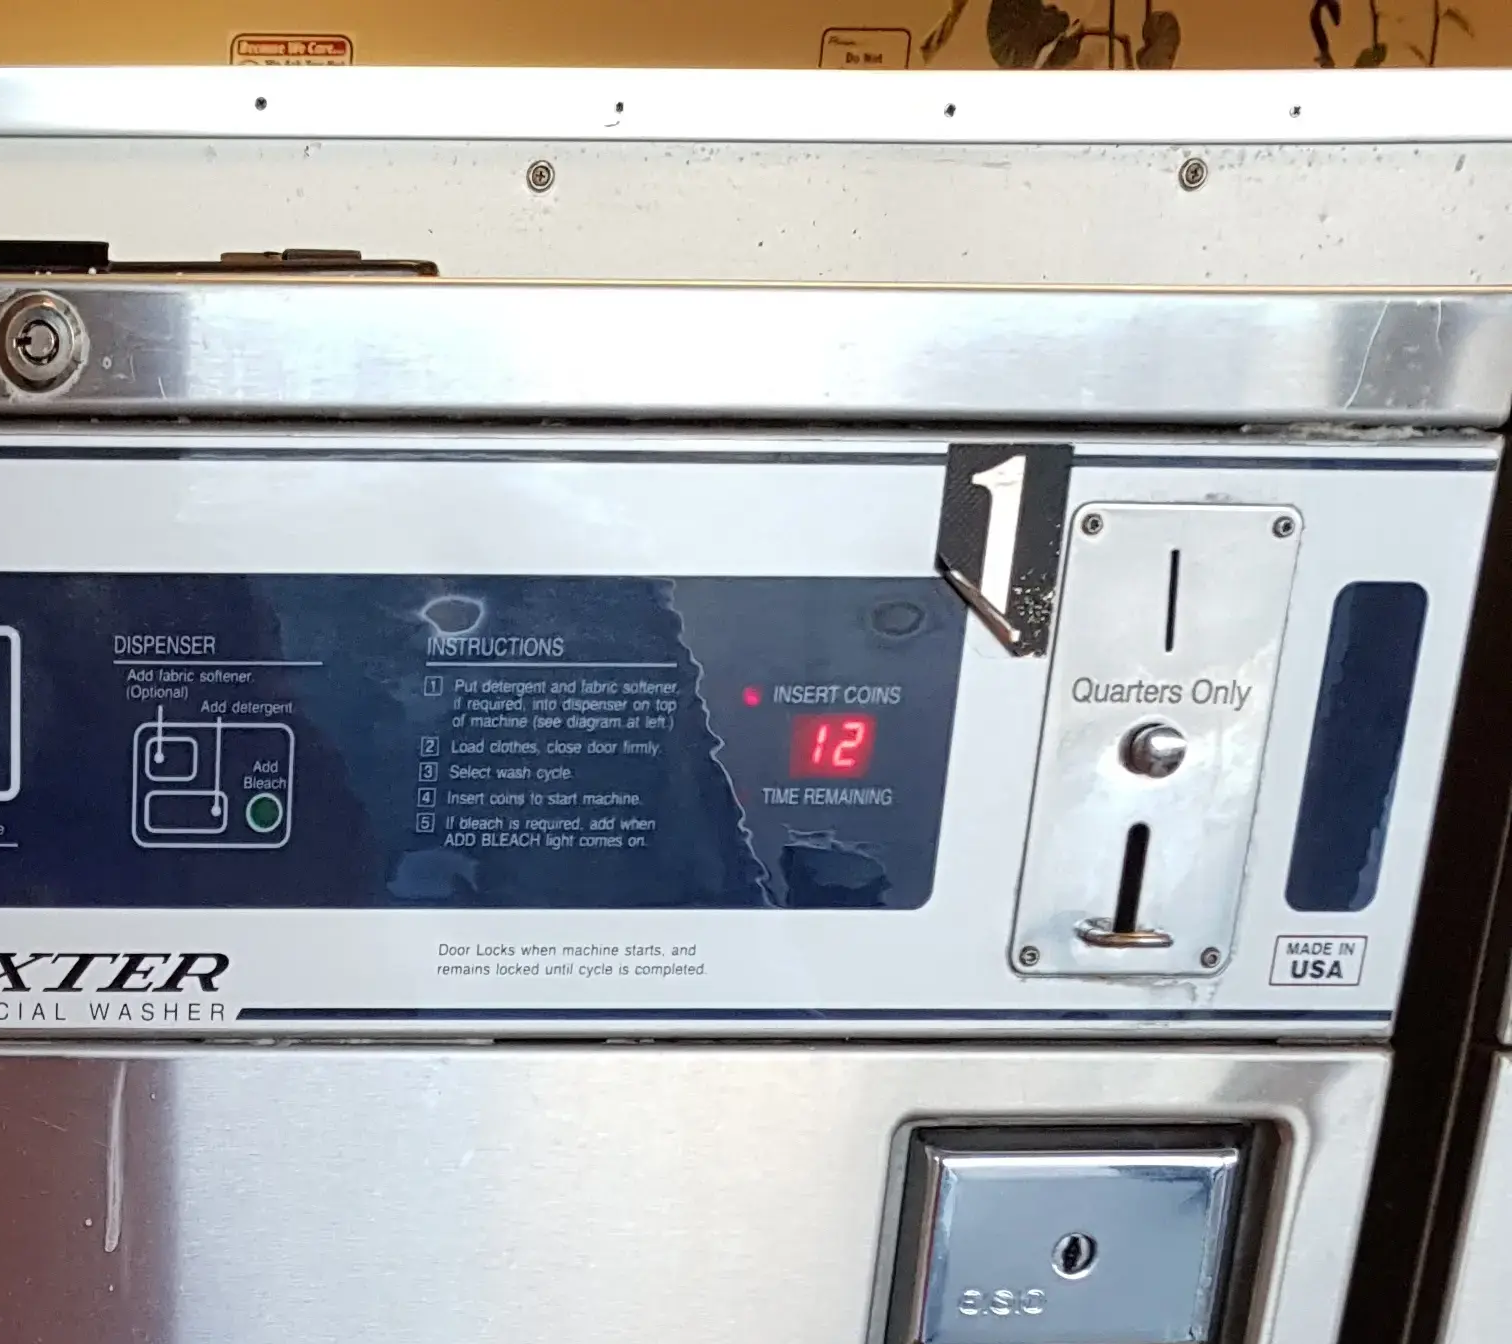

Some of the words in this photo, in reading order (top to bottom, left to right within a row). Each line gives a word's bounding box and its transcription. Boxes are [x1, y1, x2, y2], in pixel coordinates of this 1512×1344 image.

[970, 453, 1027, 617] 1
[114, 635, 216, 655] DISPENSER
[427, 637, 564, 657] INSTRUCTIONS
[127, 669, 153, 682] Add
[159, 669, 194, 682] fabric
[126, 685, 189, 700] (Optional)
[454, 679, 477, 693] Put
[482, 679, 546, 696] detergent
[550, 680, 576, 694] and
[581, 680, 617, 694] fabric
[773, 685, 840, 704] INSERT
[844, 685, 902, 704] COINS
[1072, 677, 1182, 707] Quarters
[1191, 678, 1252, 711] Only
[201, 700, 226, 713] Add
[231, 701, 293, 717] detergent
[532, 697, 557, 710] into
[562, 697, 627, 714] dispenser
[633, 699, 650, 710] on
[656, 698, 677, 713] top
[452, 714, 465, 728] of
[471, 715, 527, 728] machine
[533, 714, 561, 730] (see
[567, 715, 621, 731] diagram
[627, 715, 639, 728] at
[451, 740, 484, 754] Load
[547, 740, 581, 754] close
[587, 740, 617, 754] door
[811, 721, 865, 767] 12
[253, 761, 278, 773] Add
[449, 765, 491, 779] Select
[496, 765, 530, 779] wash
[244, 777, 286, 789] Bleach
[447, 791, 484, 805] Insert
[490, 791, 524, 805] coins
[530, 792, 542, 805] to
[547, 792, 576, 805] start
[762, 787, 800, 805] TIME
[803, 787, 893, 806] REMAINING
[446, 816, 455, 829] If
[460, 816, 502, 830] bleach
[508, 817, 519, 830] is
[590, 816, 615, 830] add
[620, 817, 656, 830] when
[444, 833, 475, 847] ADD
[481, 833, 540, 847] BLEACH
[546, 833, 573, 850] light
[579, 834, 622, 847] comes
[438, 943, 470, 956] Door
[476, 943, 515, 956] Locks
[521, 943, 556, 956] when
[562, 943, 619, 956] machine
[624, 944, 665, 958] starts,
[671, 944, 696, 956] and
[1286, 942, 1333, 957] MADE
[1339, 942, 1355, 957] IN
[437, 963, 490, 976] remains
[496, 963, 539, 976] locked
[545, 963, 573, 976] until
[578, 963, 613, 979] cycle
[619, 963, 629, 976] is
[634, 963, 708, 978] completed.
[1291, 959, 1343, 980] USA
[90, 1001, 227, 1023] WASHER
